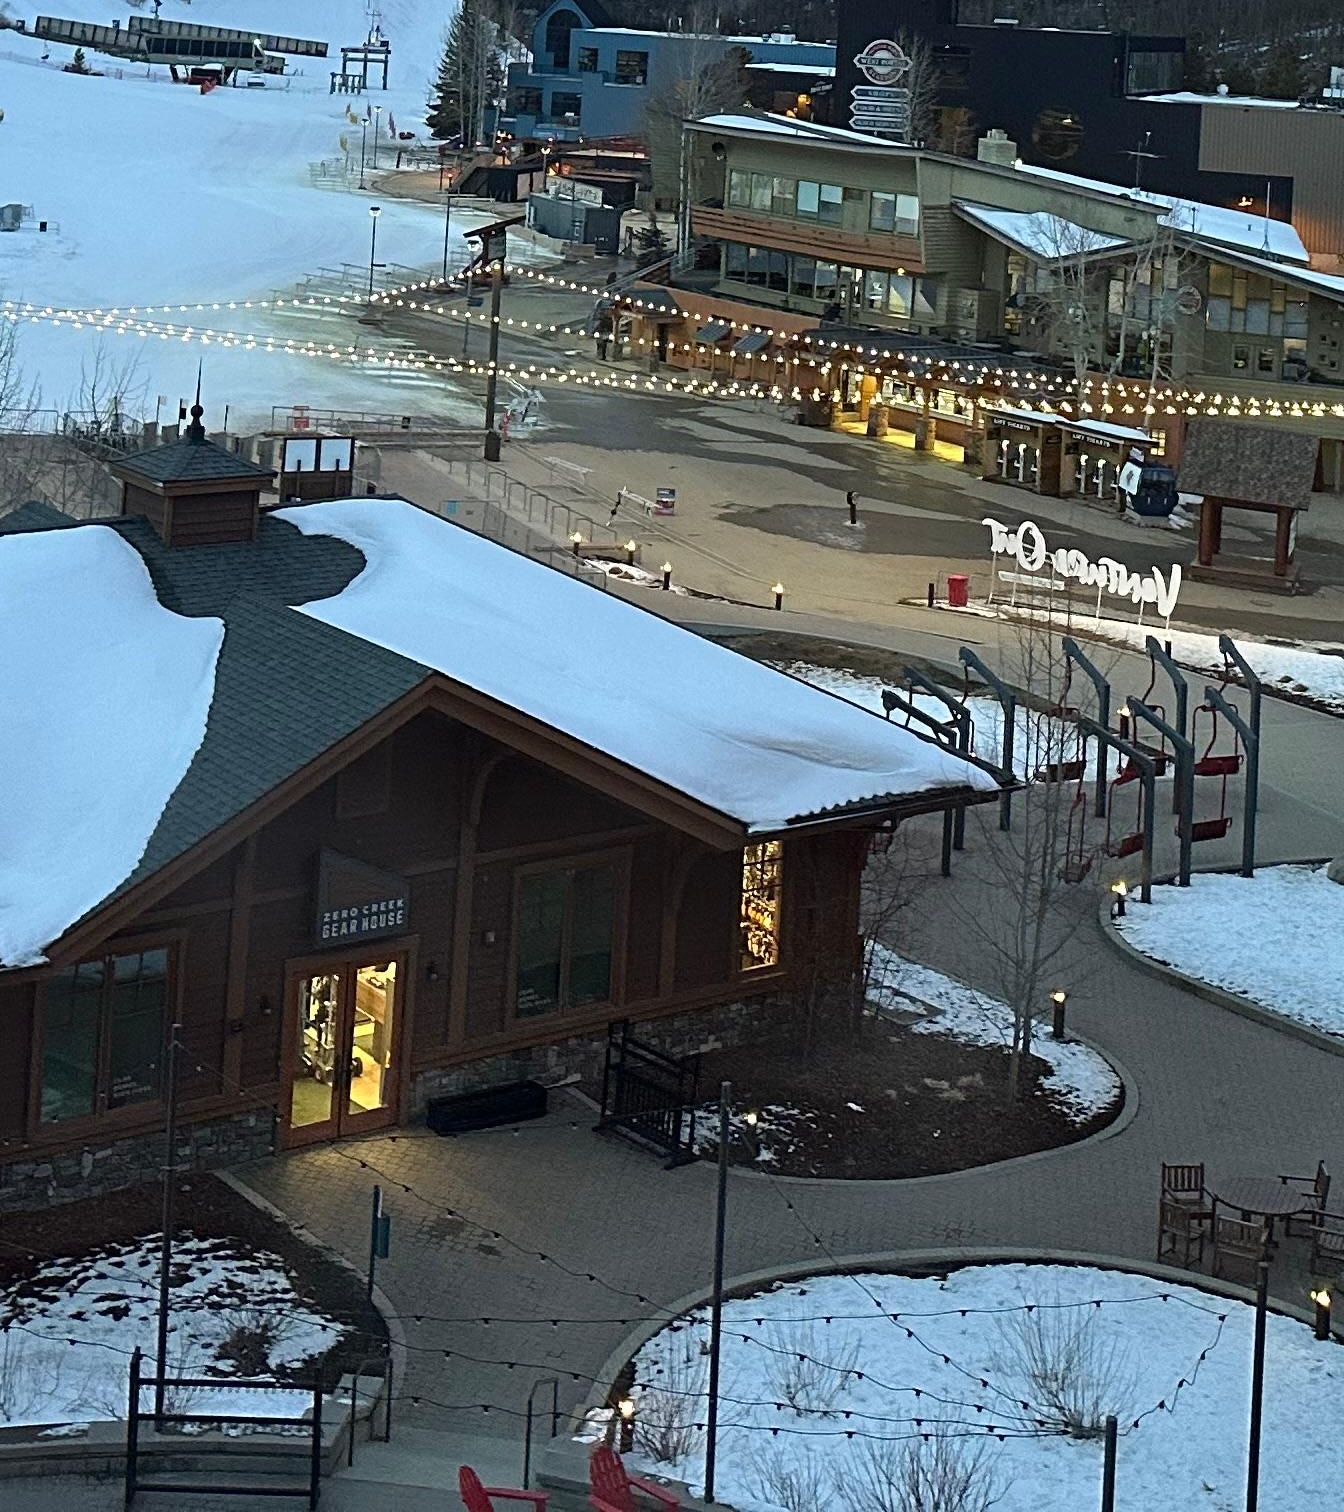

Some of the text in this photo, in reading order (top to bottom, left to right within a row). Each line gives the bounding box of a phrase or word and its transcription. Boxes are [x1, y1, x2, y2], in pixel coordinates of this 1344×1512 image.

[323, 898, 404, 922] ZERO CREEK
[322, 909, 404, 939] GEAR HOUSE
